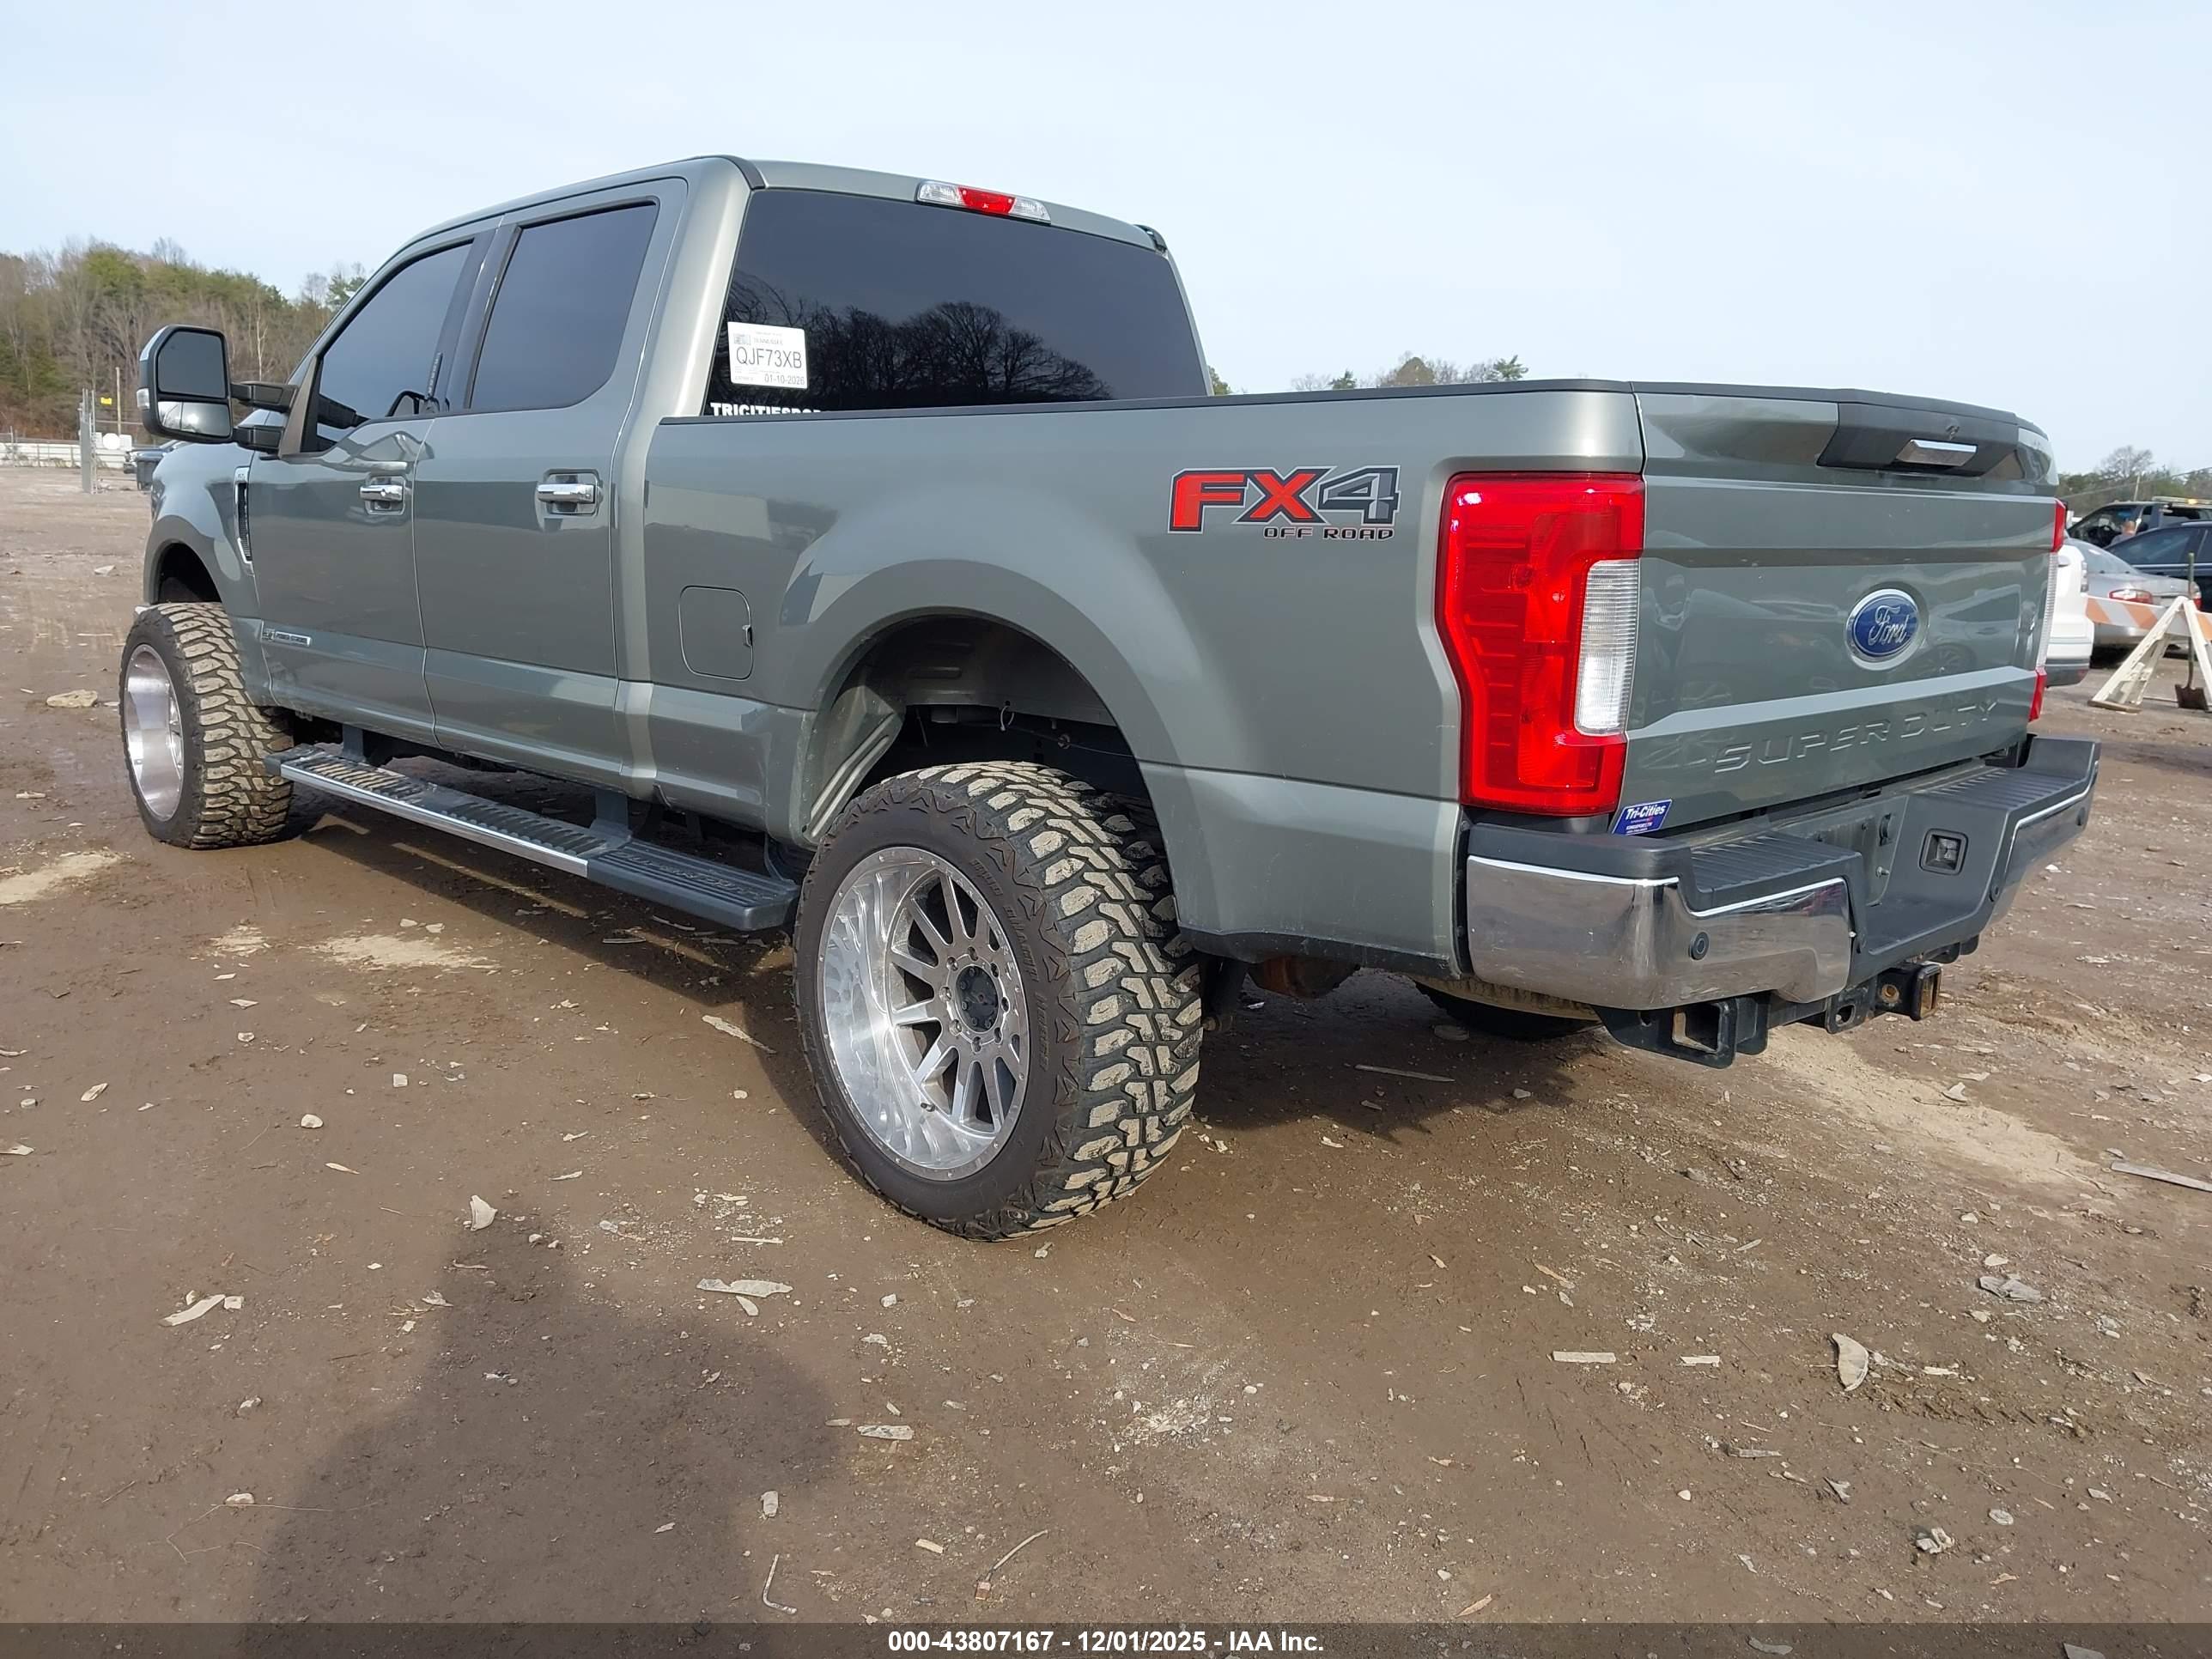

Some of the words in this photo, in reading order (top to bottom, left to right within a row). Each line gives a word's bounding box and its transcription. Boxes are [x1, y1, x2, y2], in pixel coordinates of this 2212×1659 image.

[736, 346, 802, 369] QJF73XB
[1168, 465, 1401, 534] FX4
[1262, 526, 1314, 540] OFF
[1323, 527, 1395, 542] ROAD
[1868, 605, 1911, 647] Ford
[1714, 720, 1891, 774] SUPER
[1899, 699, 1998, 739] DUTY
[1625, 804, 1667, 820] Tri-Cities
